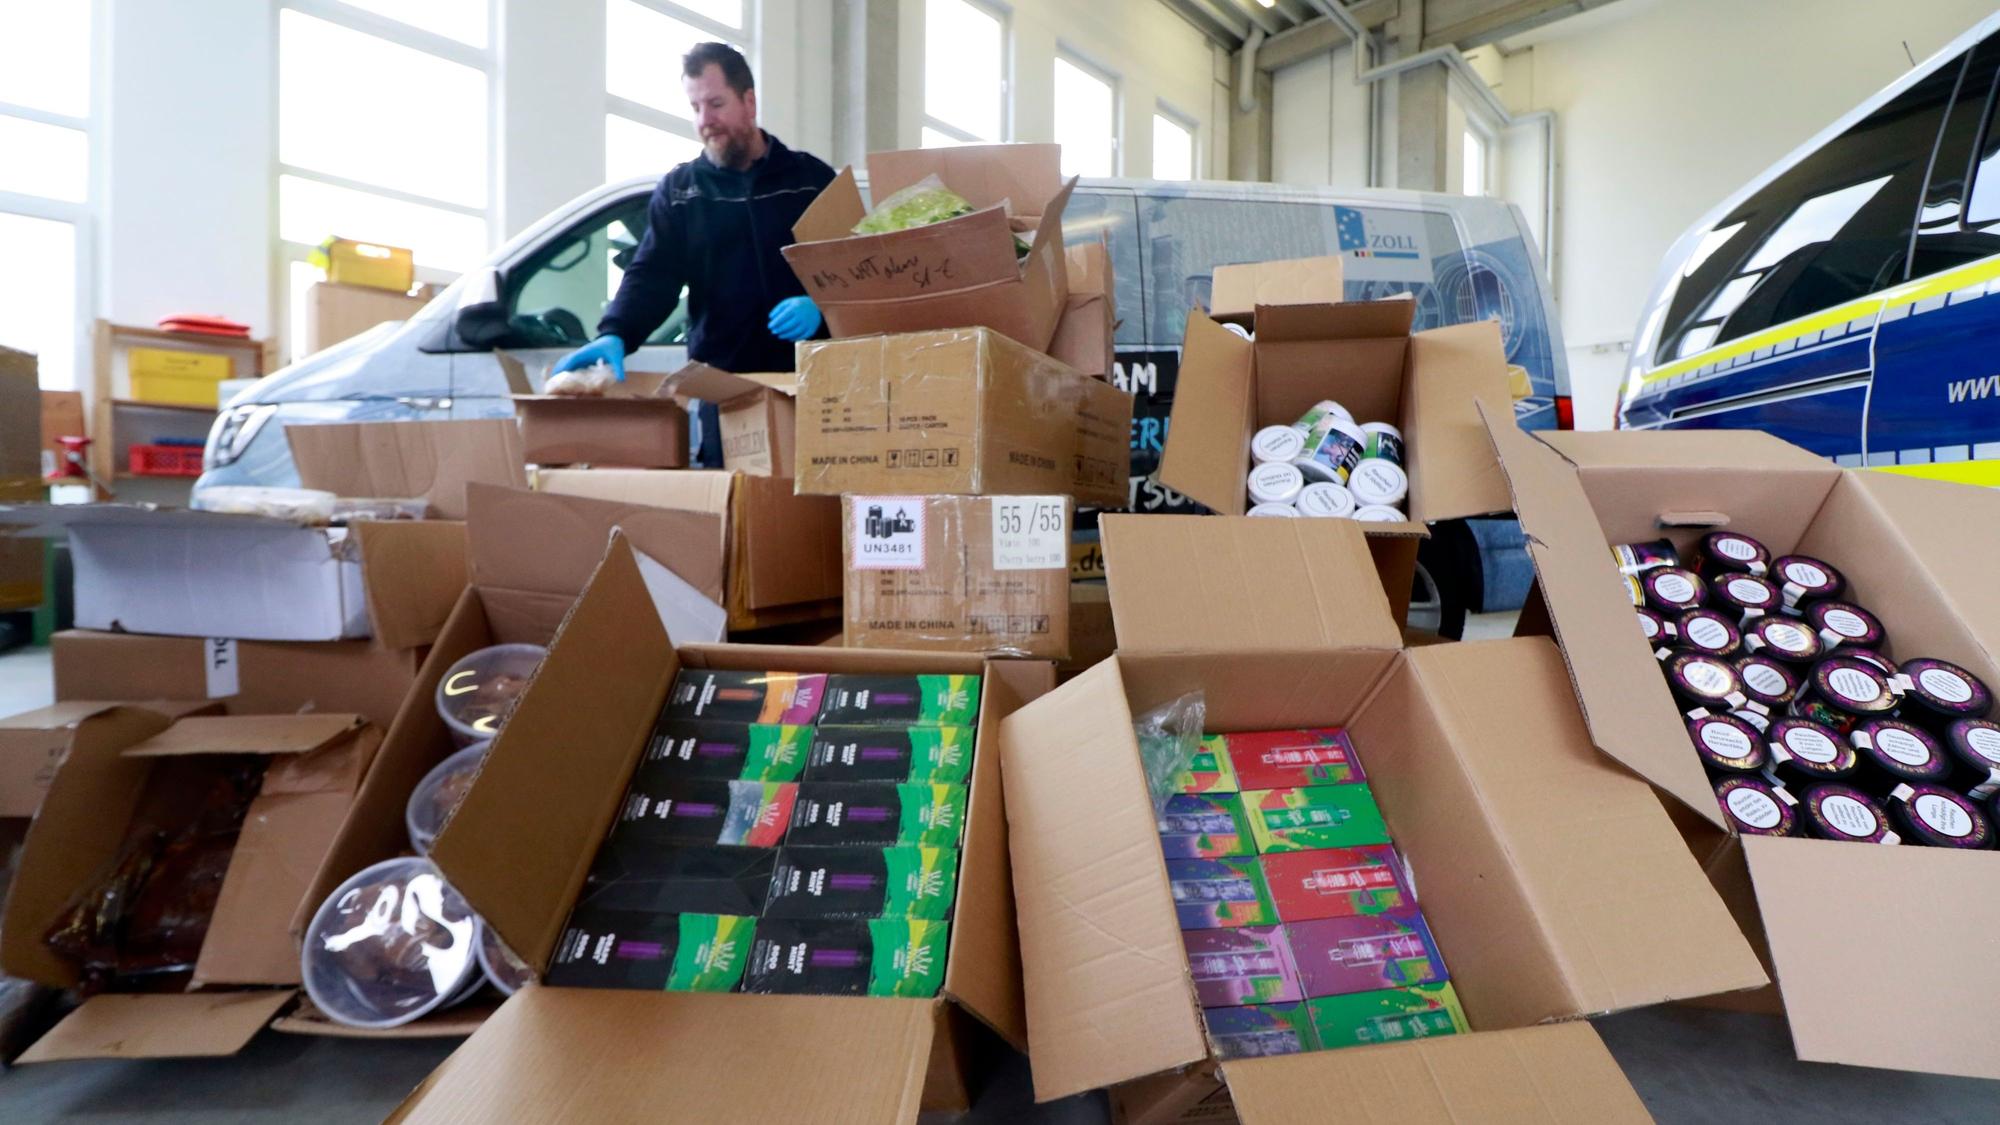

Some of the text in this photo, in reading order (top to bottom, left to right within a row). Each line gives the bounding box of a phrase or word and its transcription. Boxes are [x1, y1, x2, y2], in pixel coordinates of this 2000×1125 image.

[1371, 235, 1417, 250] ZOLL
[812, 455, 879, 465] MADE IN CHINA
[1000, 505, 1021, 534] 55
[864, 543, 912, 553] UN3481
[869, 620, 955, 630] MADE IN CHINA
[841, 745, 850, 763] MINT
[847, 743, 857, 765] GRAPE
[826, 804, 835, 823] MINT
[832, 801, 843, 827] GRAPE
[808, 871, 818, 893] MINT
[814, 868, 826, 896] GRAPE
[592, 936, 607, 961] MINT
[598, 933, 616, 965] GRAPE
[787, 946, 798, 971] MINT
[794, 942, 807, 974] GRAPE
